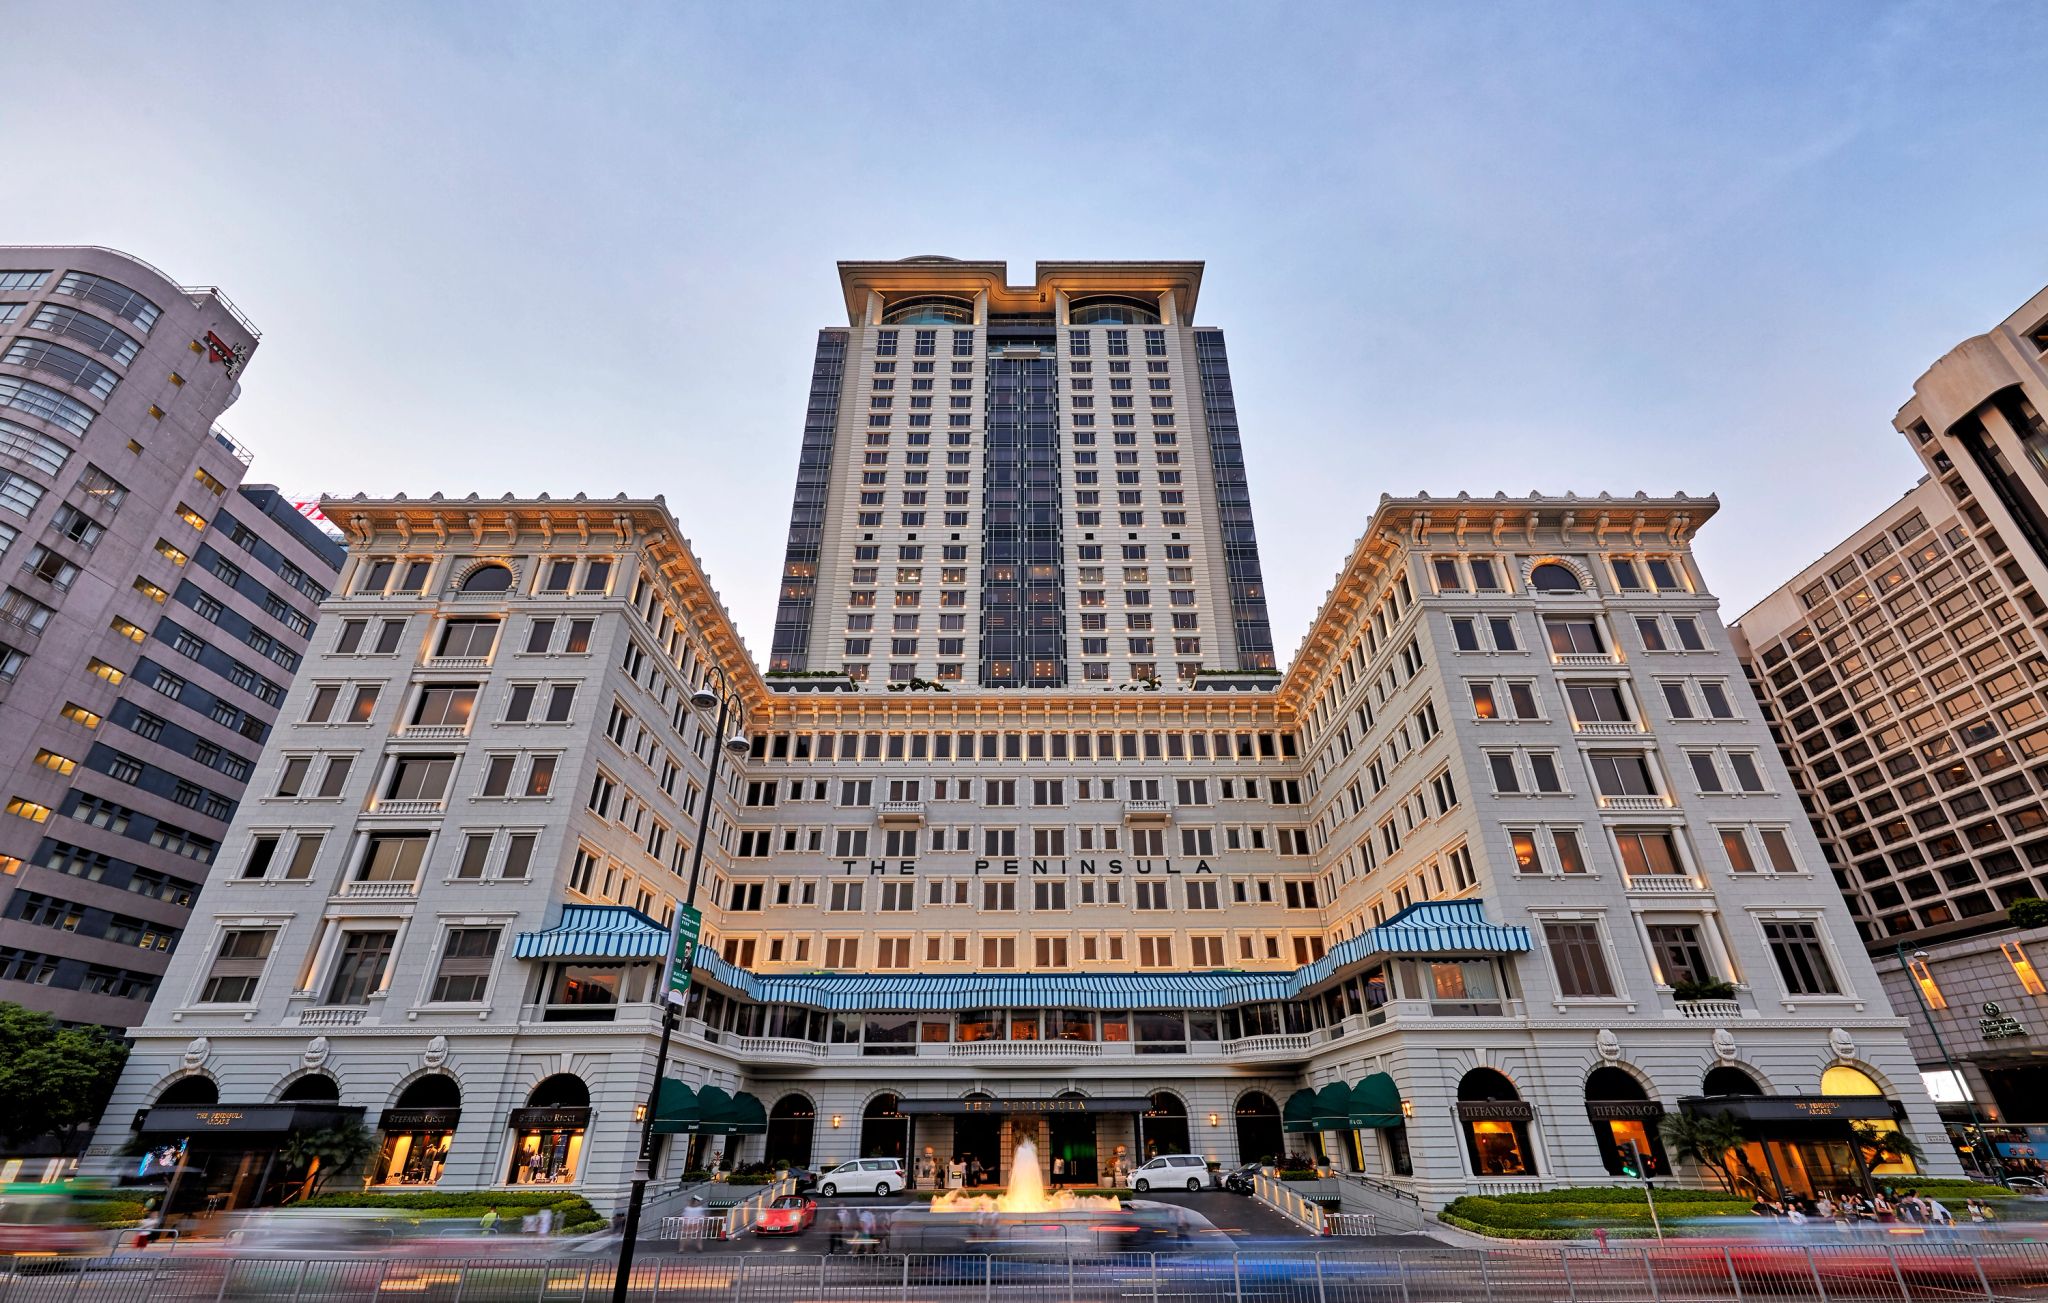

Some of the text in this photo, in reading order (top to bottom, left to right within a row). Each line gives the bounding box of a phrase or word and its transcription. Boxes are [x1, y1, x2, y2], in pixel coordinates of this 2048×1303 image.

[843, 860, 1213, 875] THE PENINSULA
[964, 1101, 1086, 1111] THE PENINSULA
[554, 1113, 576, 1122] RICCI
